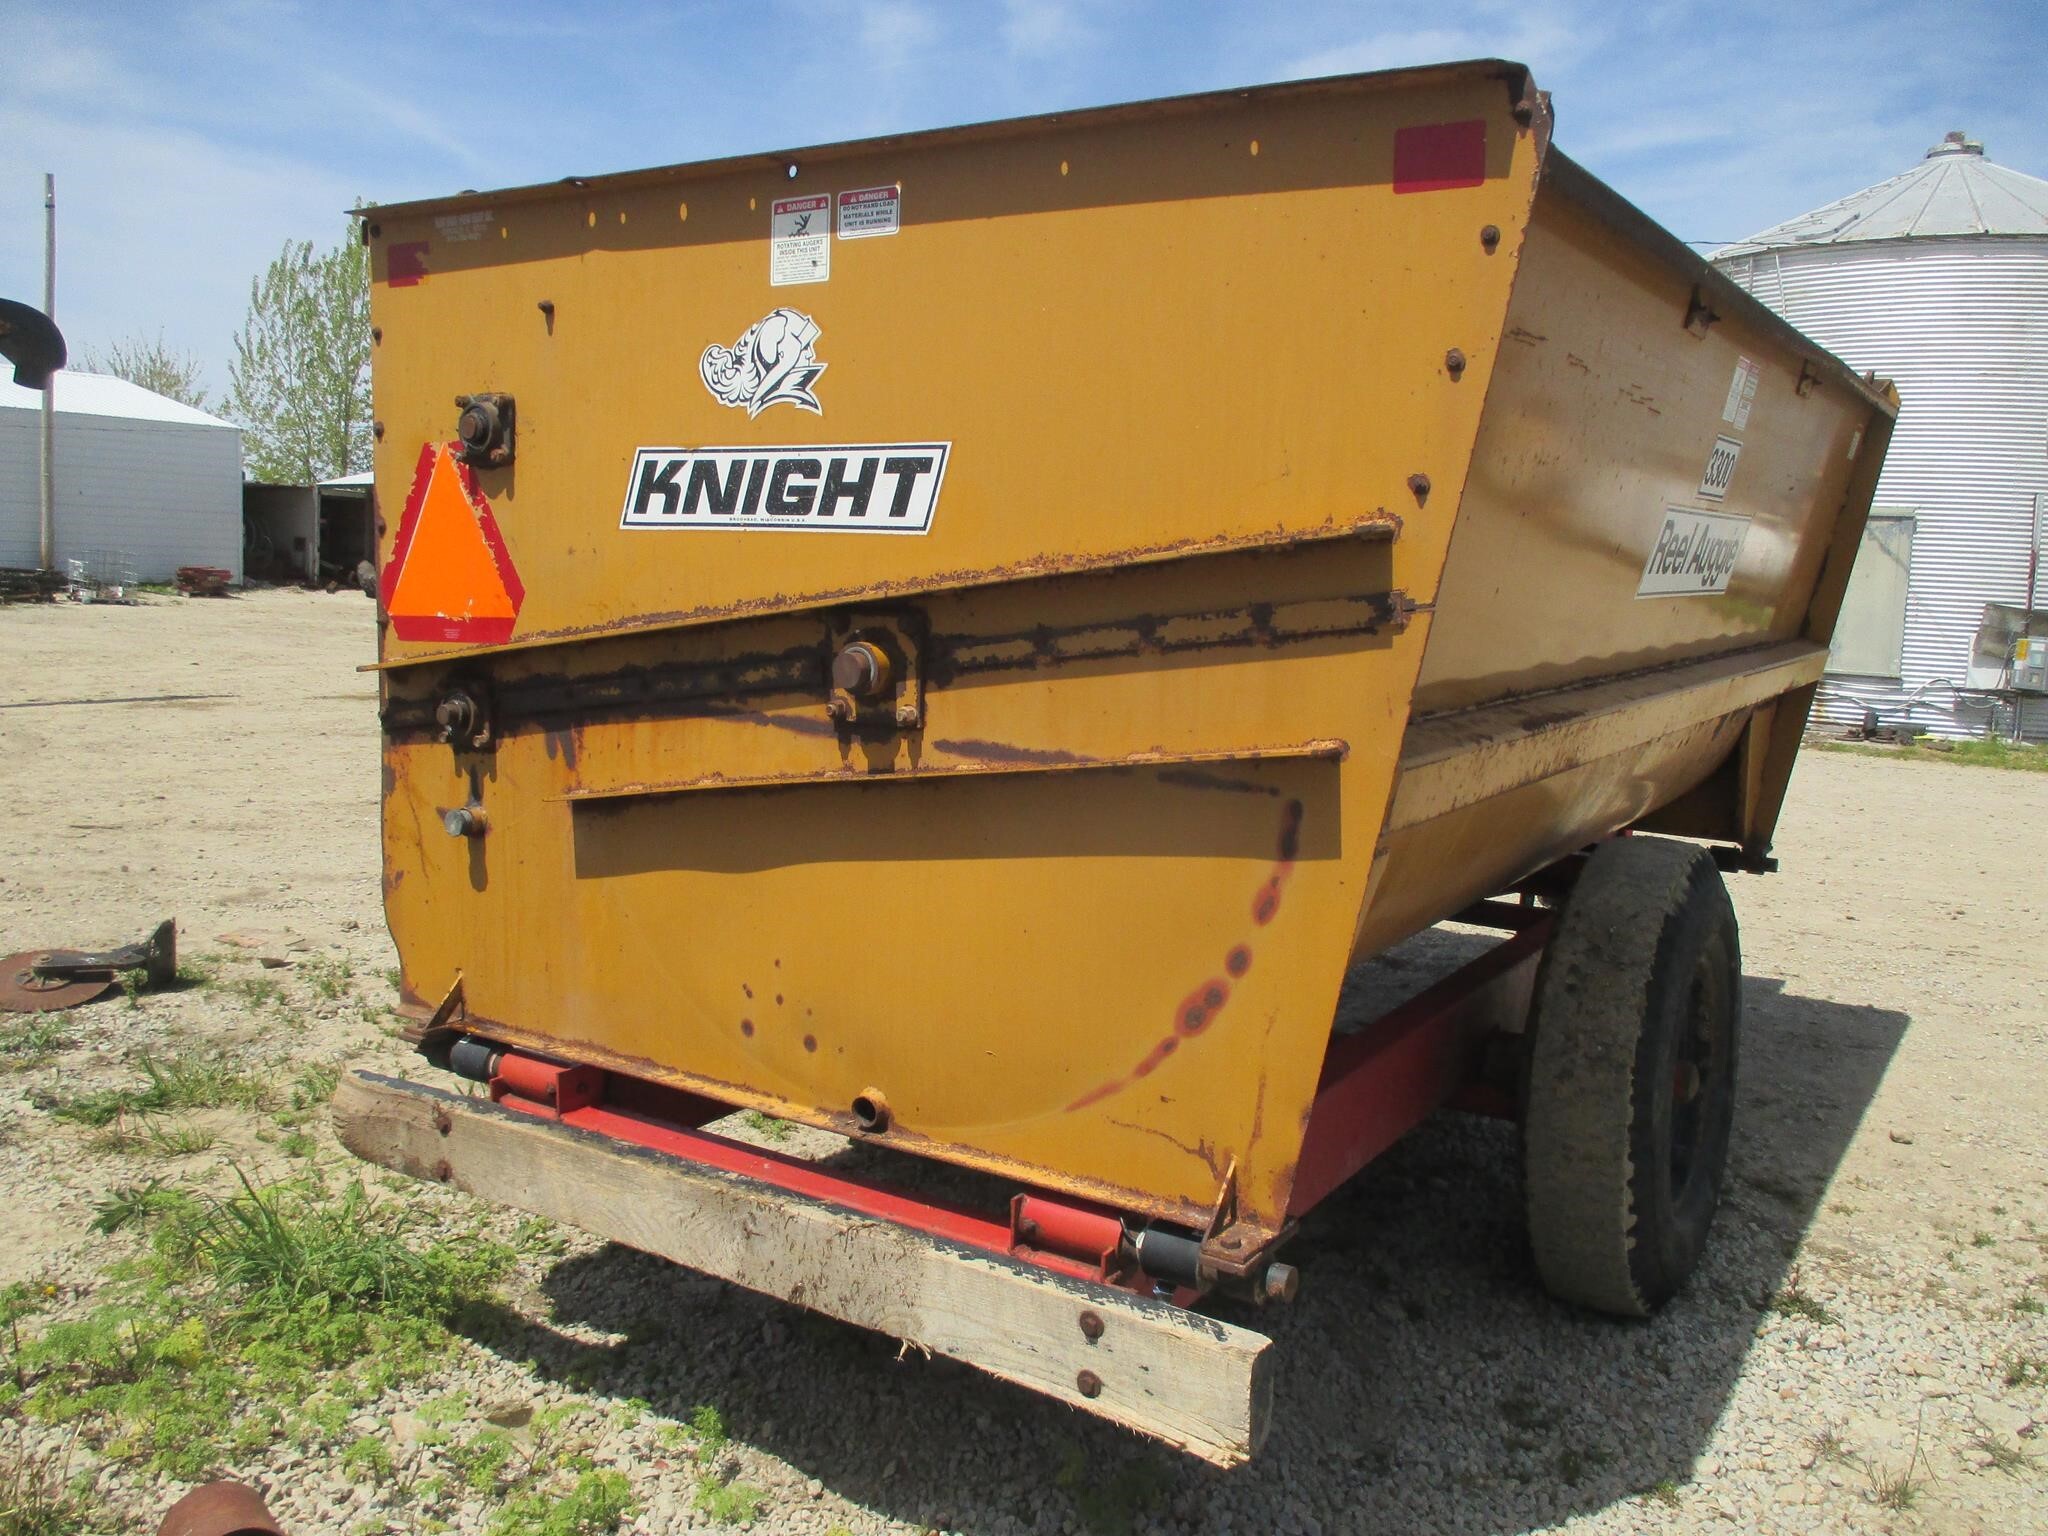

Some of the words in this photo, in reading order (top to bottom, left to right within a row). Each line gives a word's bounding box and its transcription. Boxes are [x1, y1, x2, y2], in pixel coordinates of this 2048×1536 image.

[858, 191, 889, 202] DANGER
[786, 200, 817, 212] DANGER
[843, 210, 874, 219] MATERIALS
[875, 208, 893, 216] WHILE
[865, 217, 892, 225] RUNNING
[776, 242, 802, 250] ROTATING
[802, 239, 824, 247] AUGERS
[1703, 447, 1736, 489] 3300
[632, 456, 934, 518] KNIGHT
[1647, 519, 1700, 575] Reel
[1685, 523, 1740, 587] Auggie
